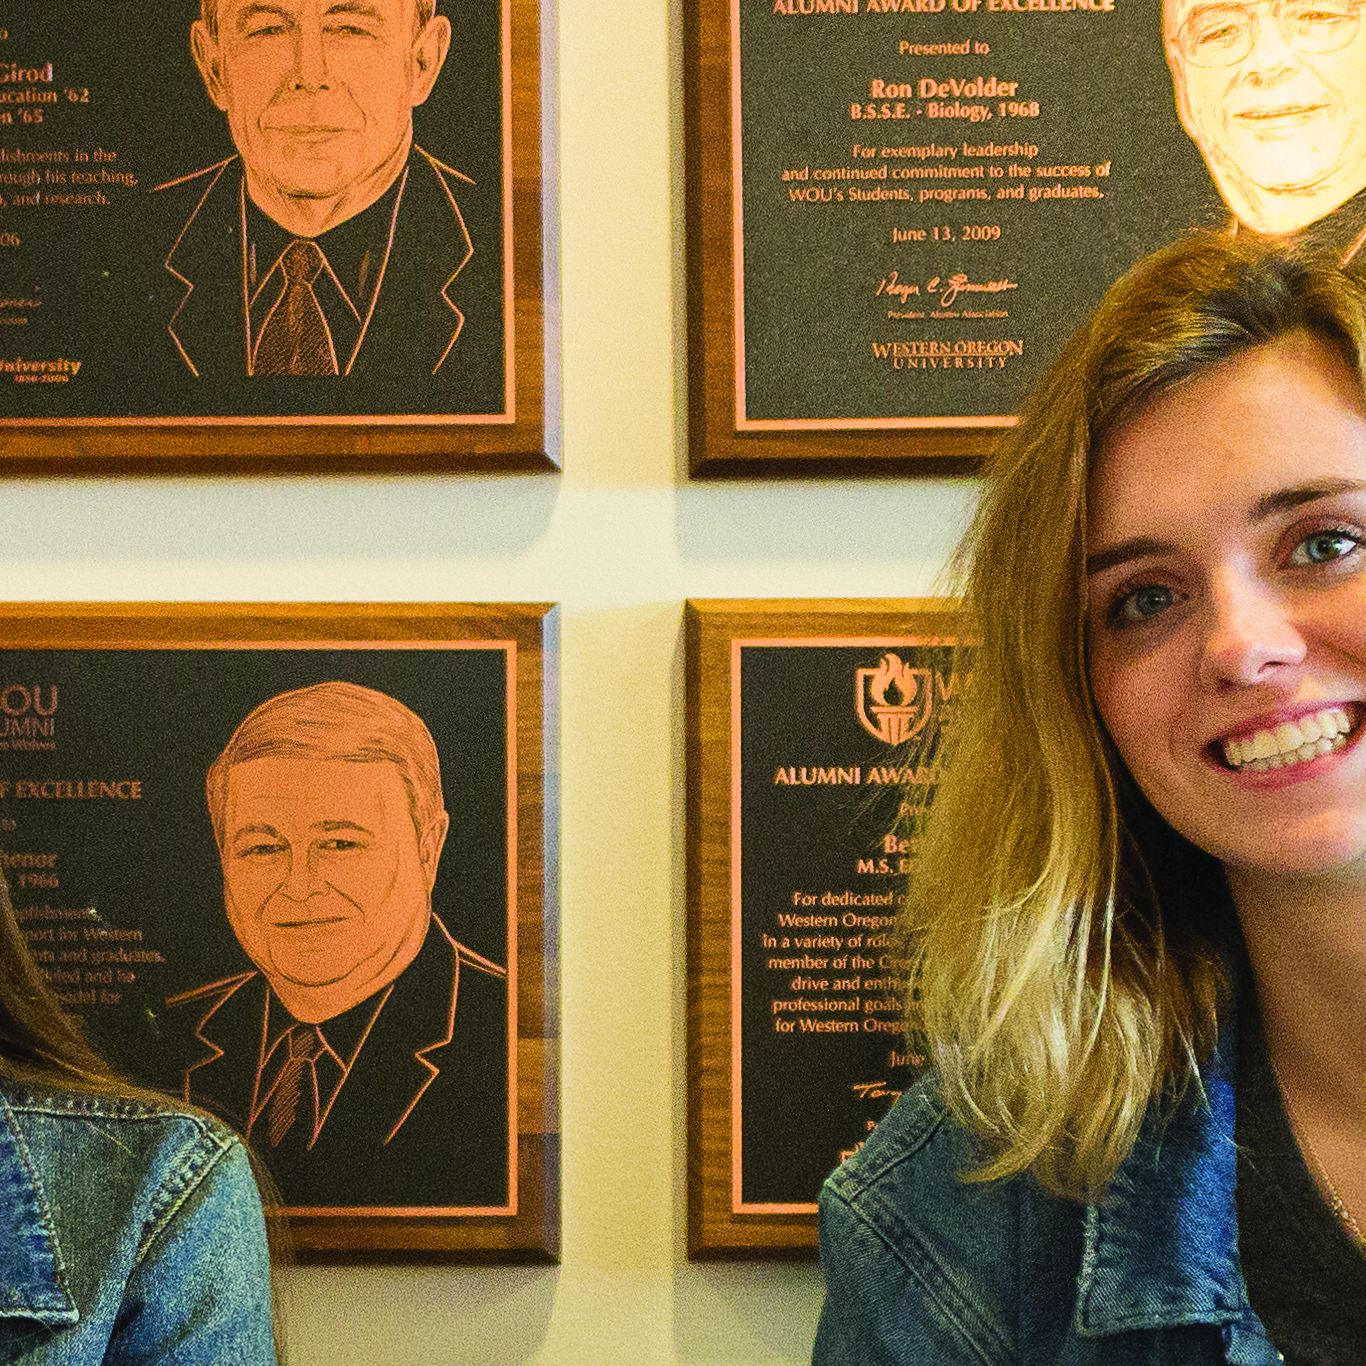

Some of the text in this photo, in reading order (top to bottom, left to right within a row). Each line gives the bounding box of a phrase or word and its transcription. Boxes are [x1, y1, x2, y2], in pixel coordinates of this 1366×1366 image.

[773, 0, 858, 13] ALUMNI
[866, 0, 945, 12] AWARD
[988, 0, 1115, 12] EXCELLENCE
[899, 40, 990, 55] Presented to
[870, 76, 1019, 99] Ron DeVolder
[850, 103, 910, 119] B.S.S.E.
[928, 102, 992, 122] Biology,
[998, 101, 1040, 117] 1968
[852, 142, 1039, 160] For exemplary leadership
[781, 160, 1111, 181] and continued commitment to the success of
[788, 184, 1104, 204] WOU's Students, programs, and graduates.
[892, 226, 1001, 243] June 13, 2009
[872, 340, 1023, 358] WESTERN OREGON
[893, 357, 1007, 370] UNIVERSITY
[774, 767, 861, 785] ALUMNI
[15, 780, 142, 799] EXCELLENCE
[857, 859, 894, 874] M.S.
[792, 890, 892, 905] For dedicated
[778, 913, 838, 927] Western
[762, 934, 862, 951] in a variety of
[768, 955, 875, 969] member of the
[791, 976, 861, 990] drive and
[772, 998, 860, 1015] professional
[775, 1018, 859, 1032] for Western
[890, 1050, 925, 1067] June
